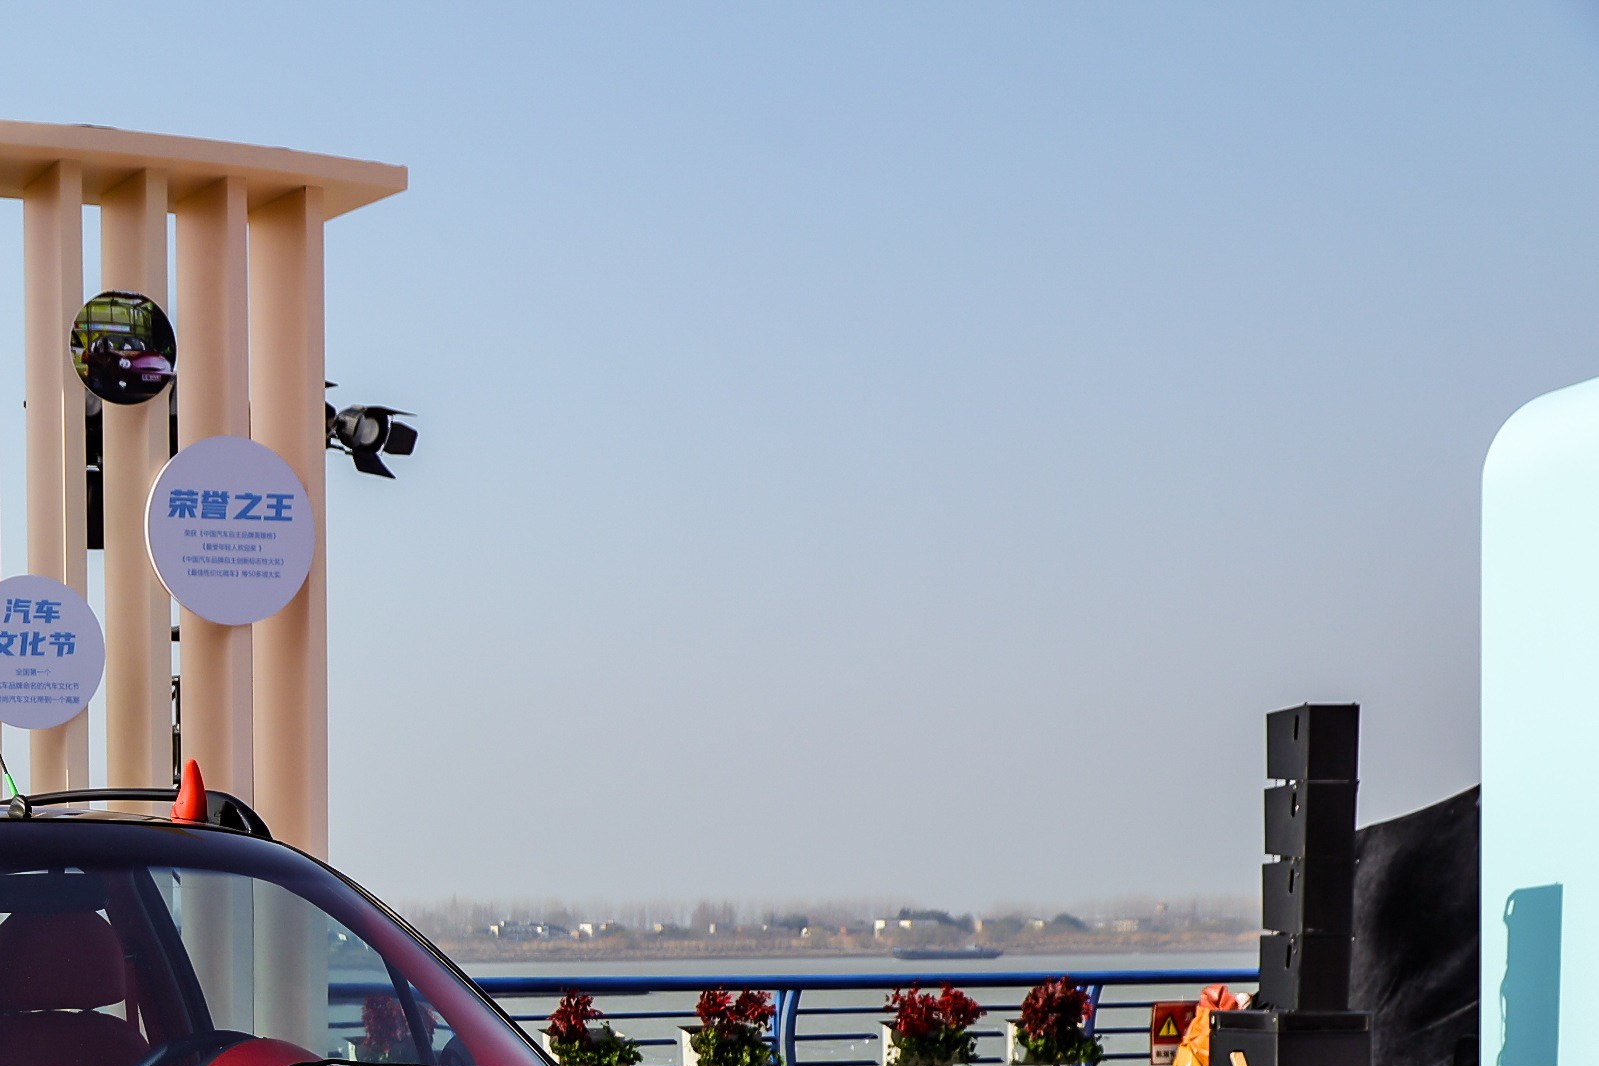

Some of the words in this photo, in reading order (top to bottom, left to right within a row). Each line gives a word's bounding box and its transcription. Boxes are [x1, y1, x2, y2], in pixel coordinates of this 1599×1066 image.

[168, 488, 295, 521] 荣誉之王
[3, 598, 62, 624] 汽车
